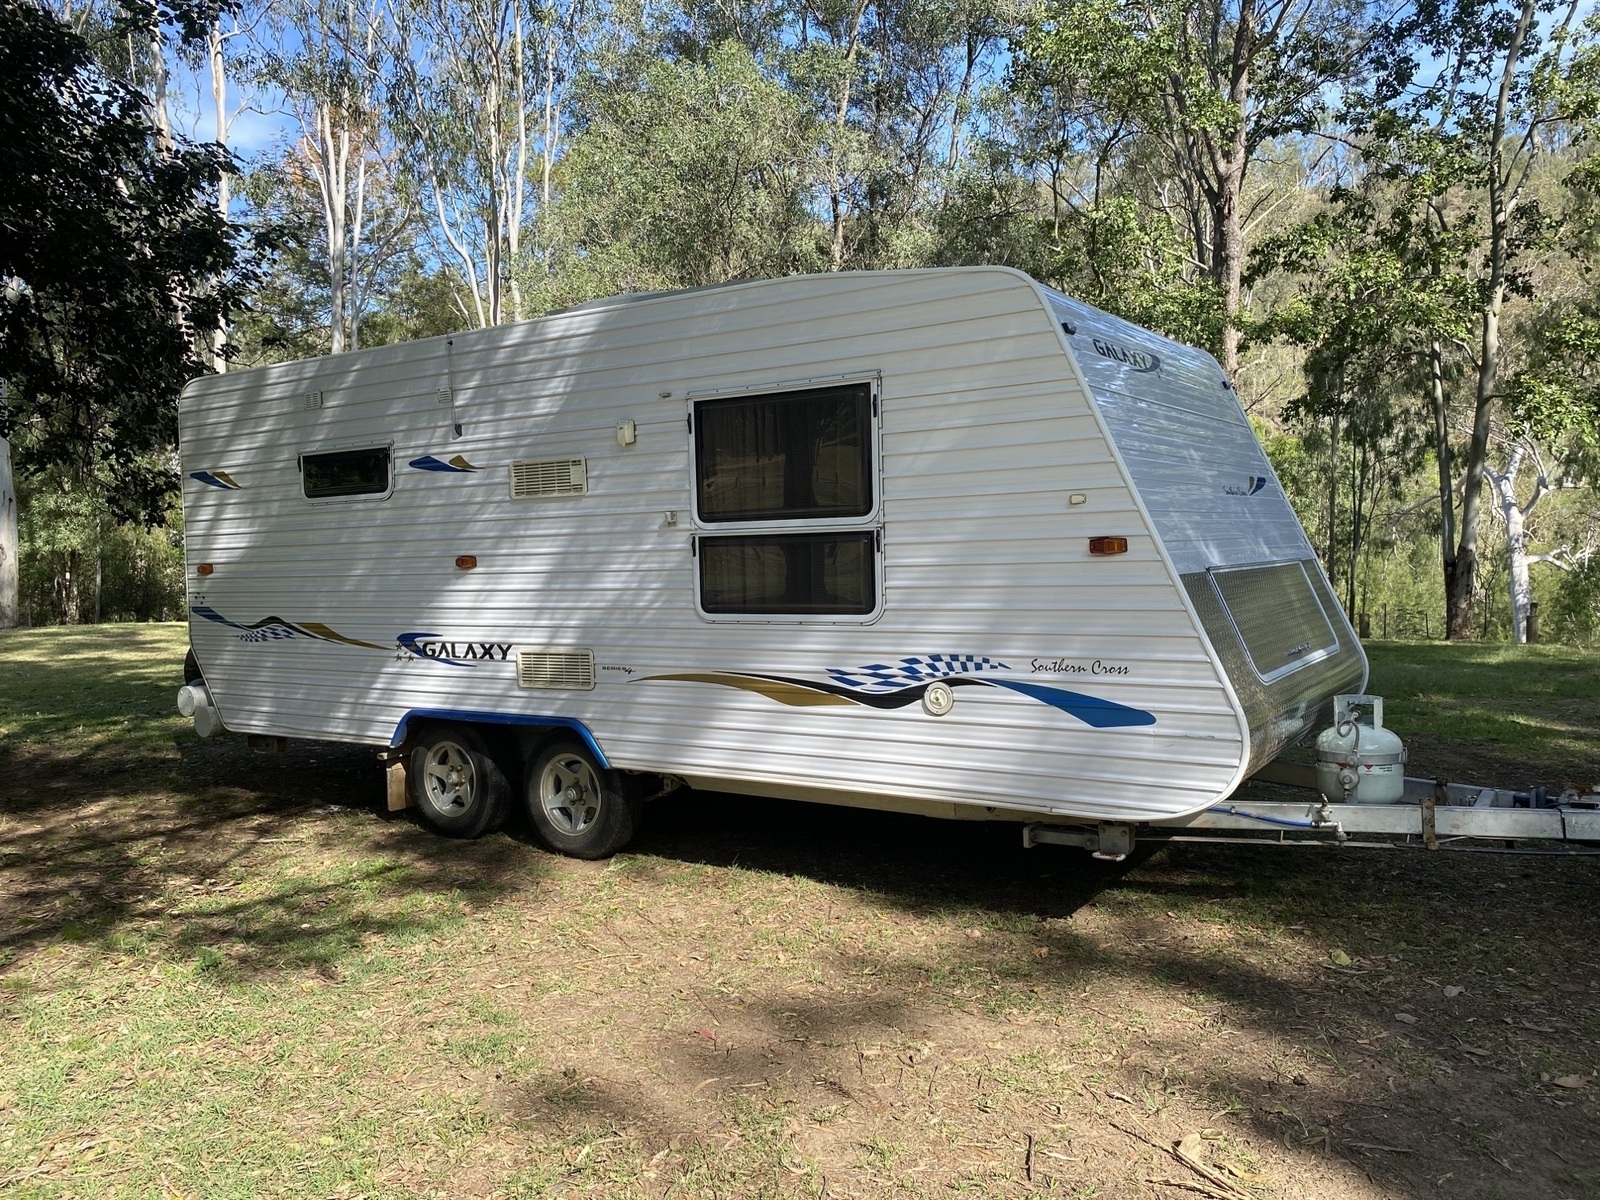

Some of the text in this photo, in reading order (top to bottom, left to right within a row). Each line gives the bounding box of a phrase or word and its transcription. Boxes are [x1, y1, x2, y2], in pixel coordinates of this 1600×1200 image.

[1092, 338, 1148, 370] GALAXY
[421, 641, 513, 660] GALAXY
[1030, 658, 1130, 675] Southern Cross
